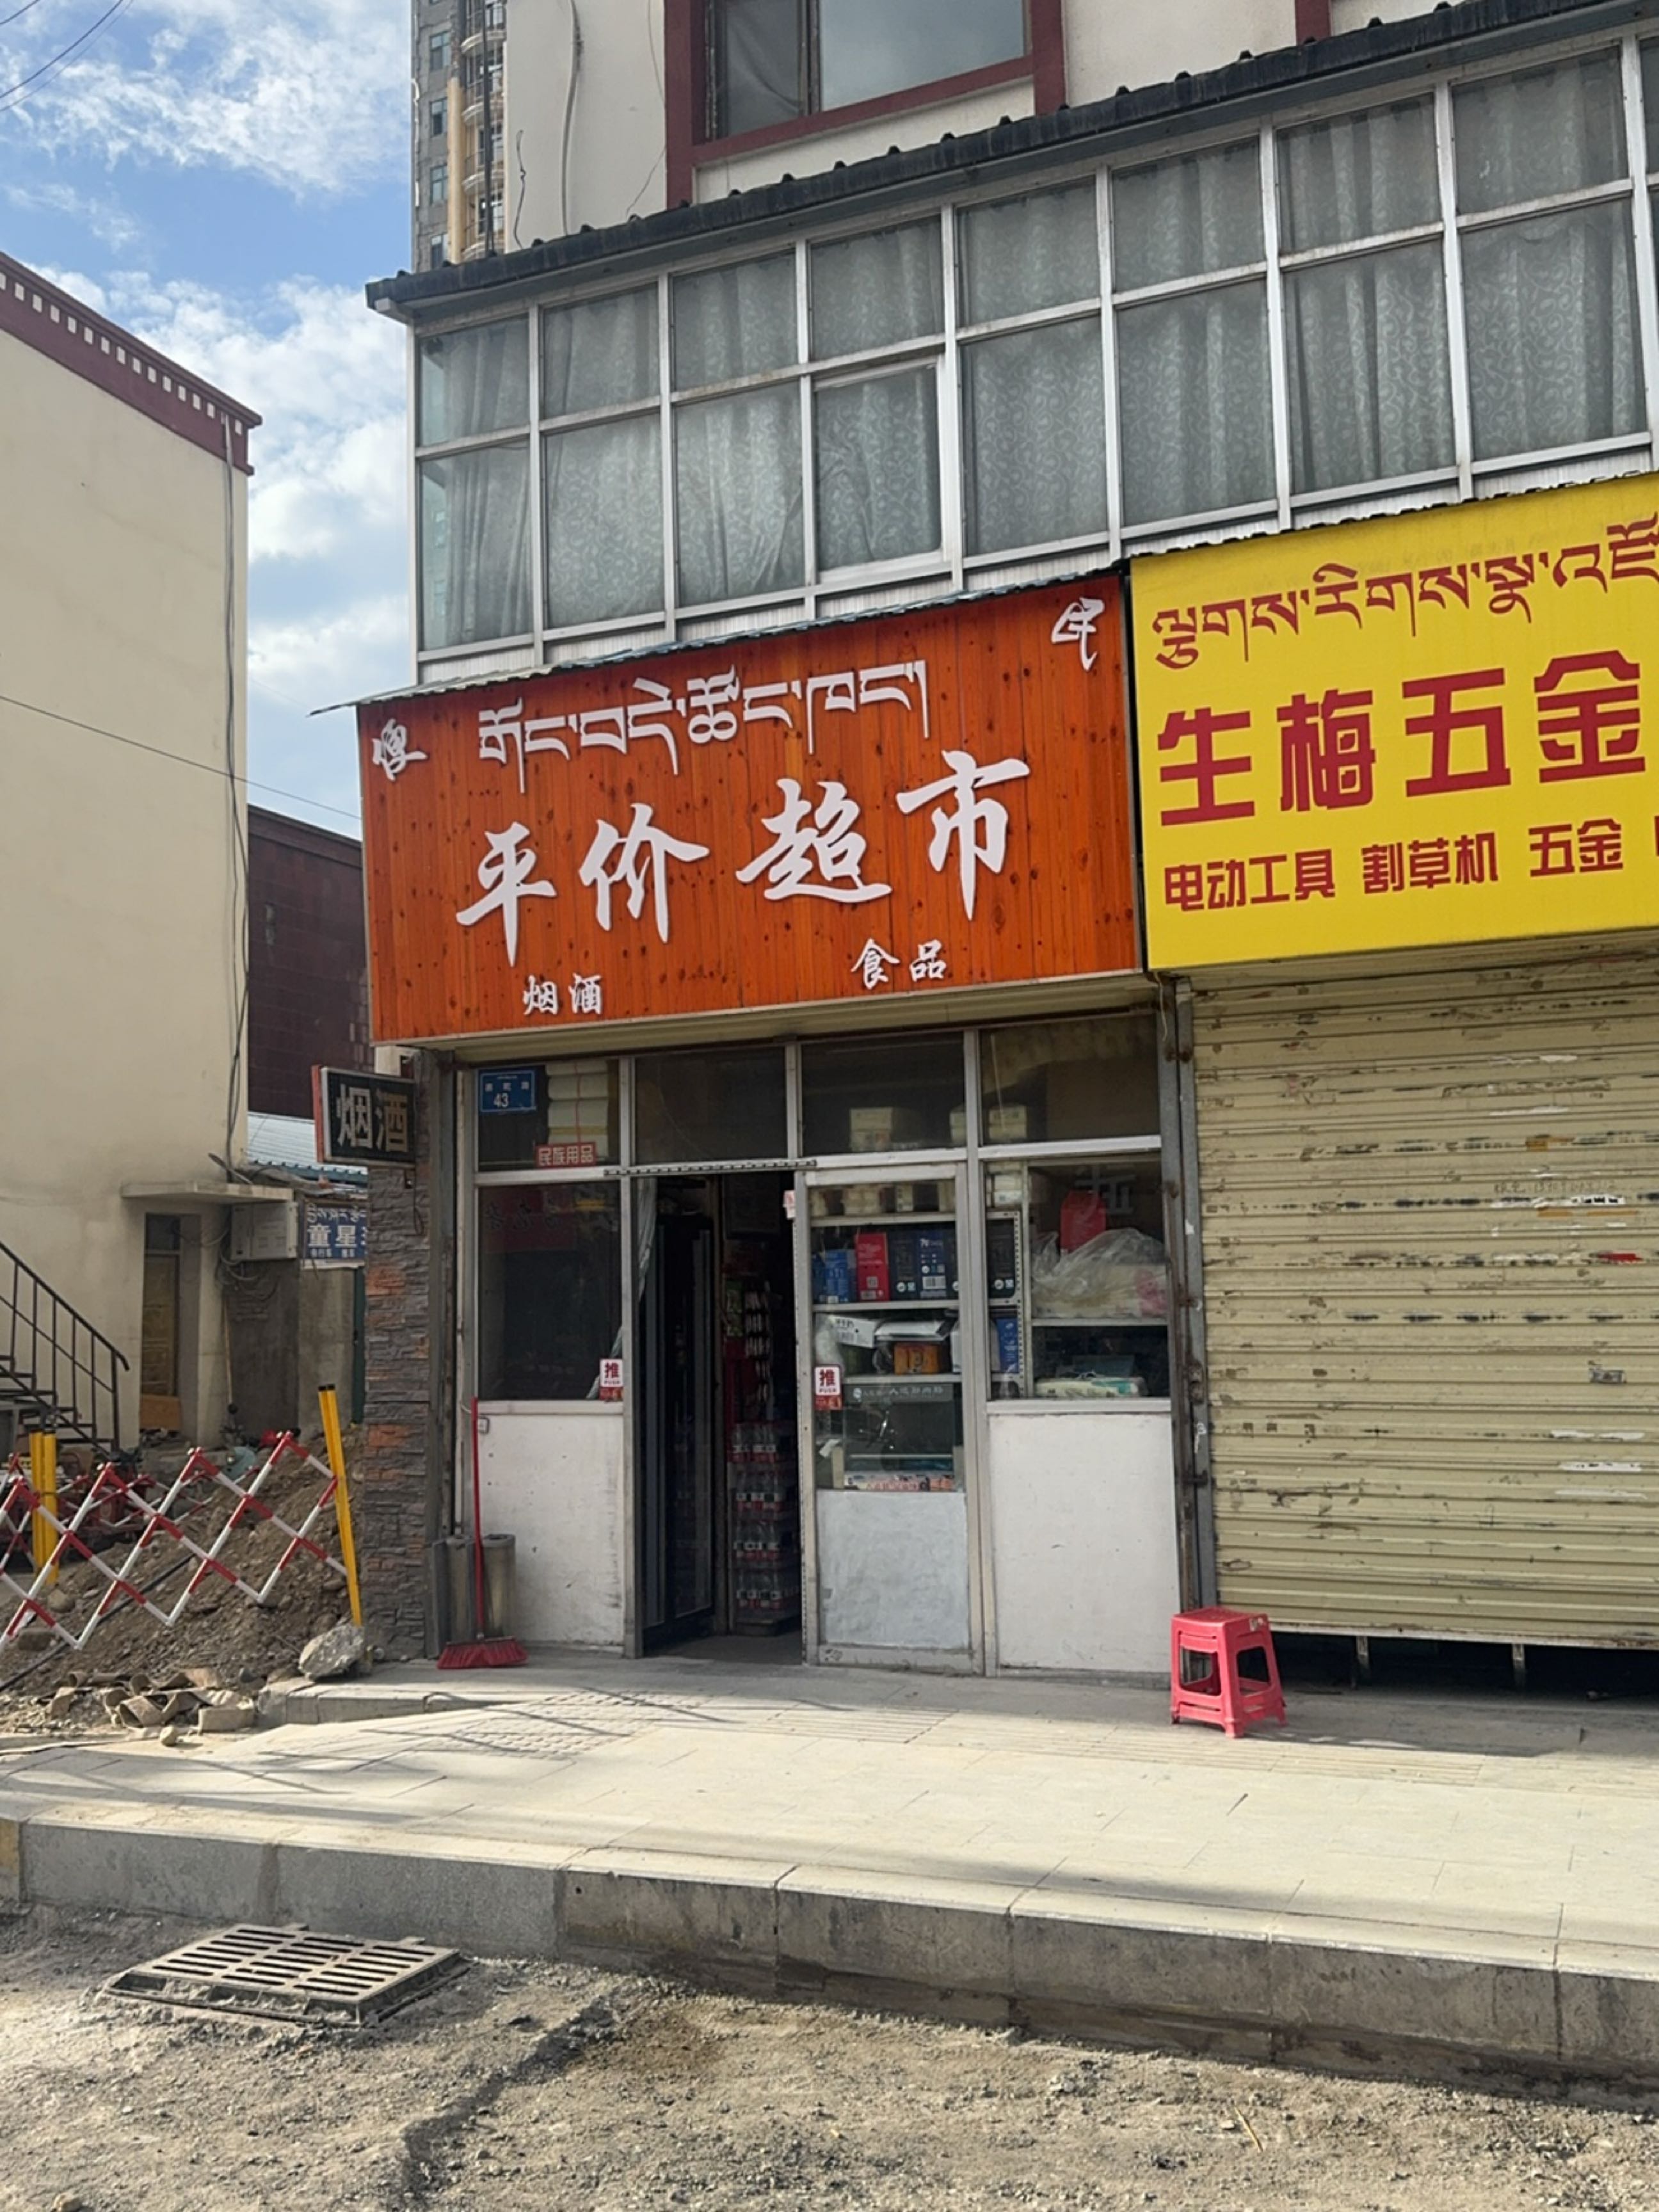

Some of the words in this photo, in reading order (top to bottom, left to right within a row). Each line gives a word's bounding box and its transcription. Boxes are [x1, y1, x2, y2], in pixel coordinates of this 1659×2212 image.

[1157, 649, 1646, 827] 生梅五金
[456, 749, 1030, 966] 平价超市
[1164, 849, 1336, 912] 电动工具
[1361, 832, 1498, 895] 割草机
[1528, 819, 1624, 878] 五金
[523, 973, 604, 1016] 烟酒
[851, 938, 947, 990] 食品
[336, 1082, 407, 1152] 烟酒
[538, 1144, 594, 1166] 民族用品
[604, 1361, 619, 1378] 推
[819, 1368, 835, 1387] 推
